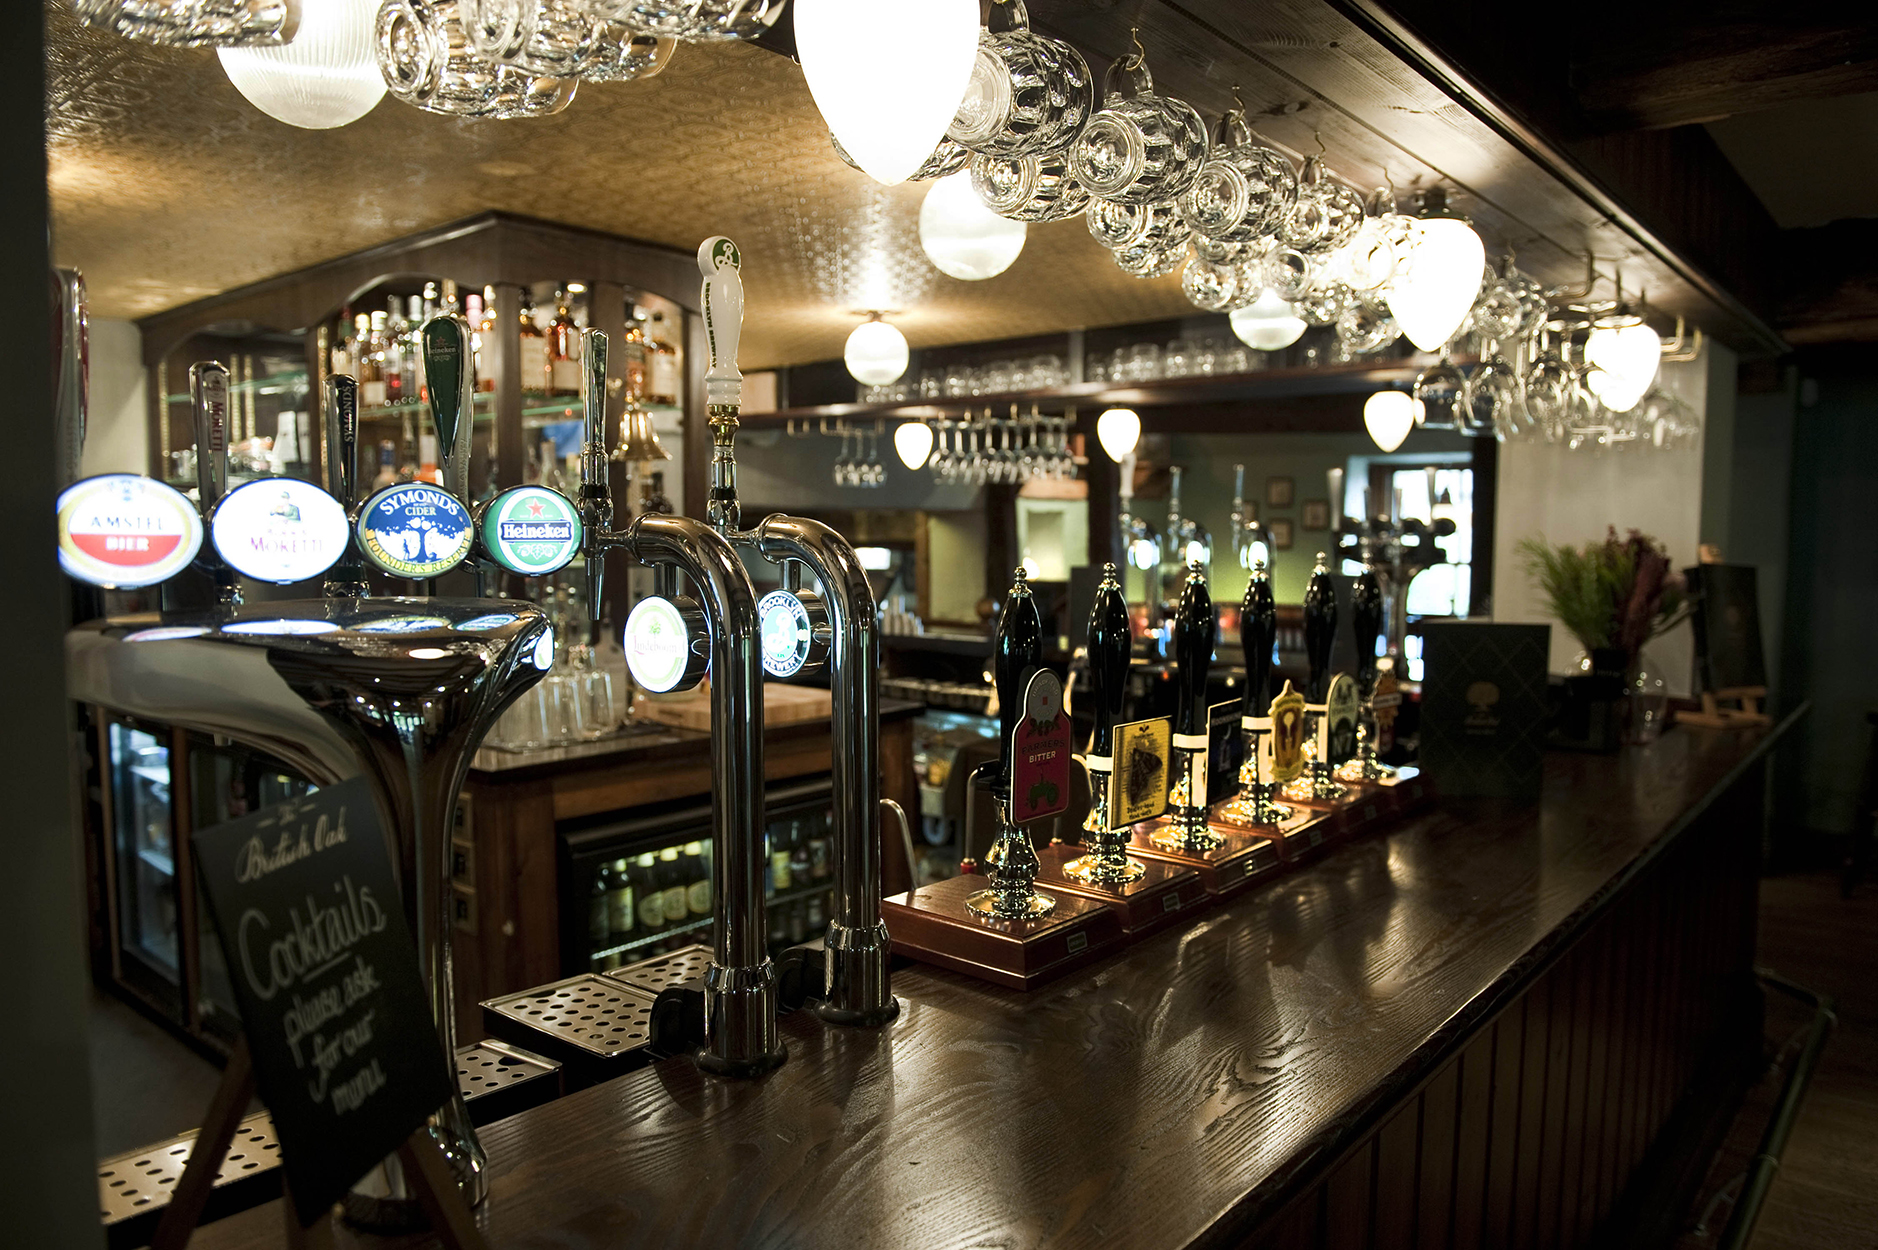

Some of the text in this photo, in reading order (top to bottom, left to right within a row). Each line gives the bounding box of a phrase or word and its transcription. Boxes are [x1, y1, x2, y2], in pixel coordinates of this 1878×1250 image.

[705, 282, 717, 368] BROOKLYN BREWERY
[210, 401, 224, 452] MORETTI
[344, 385, 355, 443] SYMONDS
[379, 490, 460, 516] SYMONDS
[405, 507, 437, 516] CIDER
[91, 516, 163, 530] AMSTEL
[503, 523, 571, 540] Heineken
[105, 536, 149, 551] BIER
[367, 535, 470, 574] FOUNDER'S RESERVE
[760, 594, 803, 620] BROOKLYN
[1021, 739, 1065, 755] FARMERS
[1028, 750, 1056, 763] BITTER
[234, 806, 348, 884] British Oak
[238, 874, 388, 1001] Cocktails
[283, 955, 382, 1069] please ask
[309, 1007, 375, 1104] for our
[331, 1056, 387, 1116] menu
